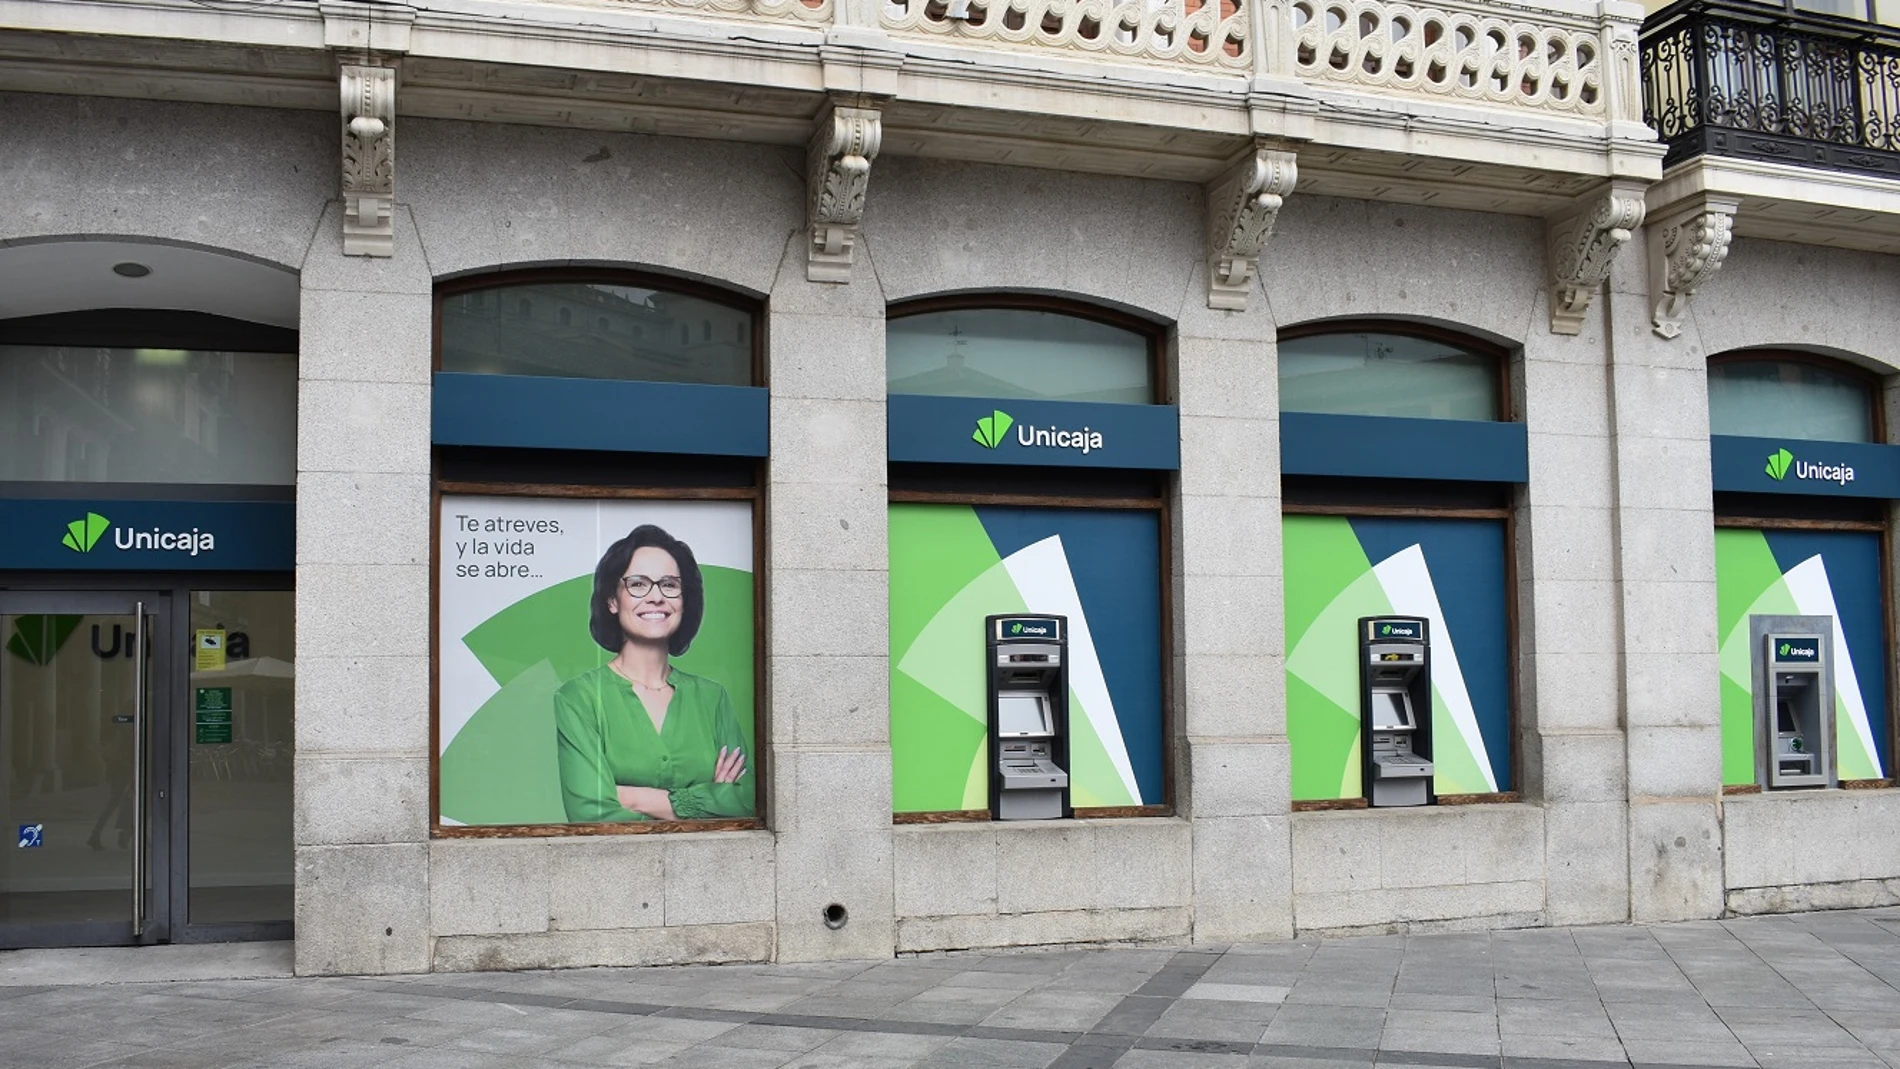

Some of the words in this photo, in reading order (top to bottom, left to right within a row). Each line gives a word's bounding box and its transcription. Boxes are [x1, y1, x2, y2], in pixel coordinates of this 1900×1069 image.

[1018, 424, 1103, 454] Unicaja
[1796, 460, 1855, 486] Unicaja
[456, 515, 479, 532] Te
[484, 516, 564, 535] atreves,
[114, 527, 215, 556] Unicaja
[456, 541, 467, 559] y
[473, 538, 489, 555] la
[494, 539, 535, 556] vida
[456, 563, 480, 578] se
[484, 561, 543, 578] abre...
[1022, 626, 1047, 635] Unicaja
[1790, 647, 1815, 658] Unicaja
